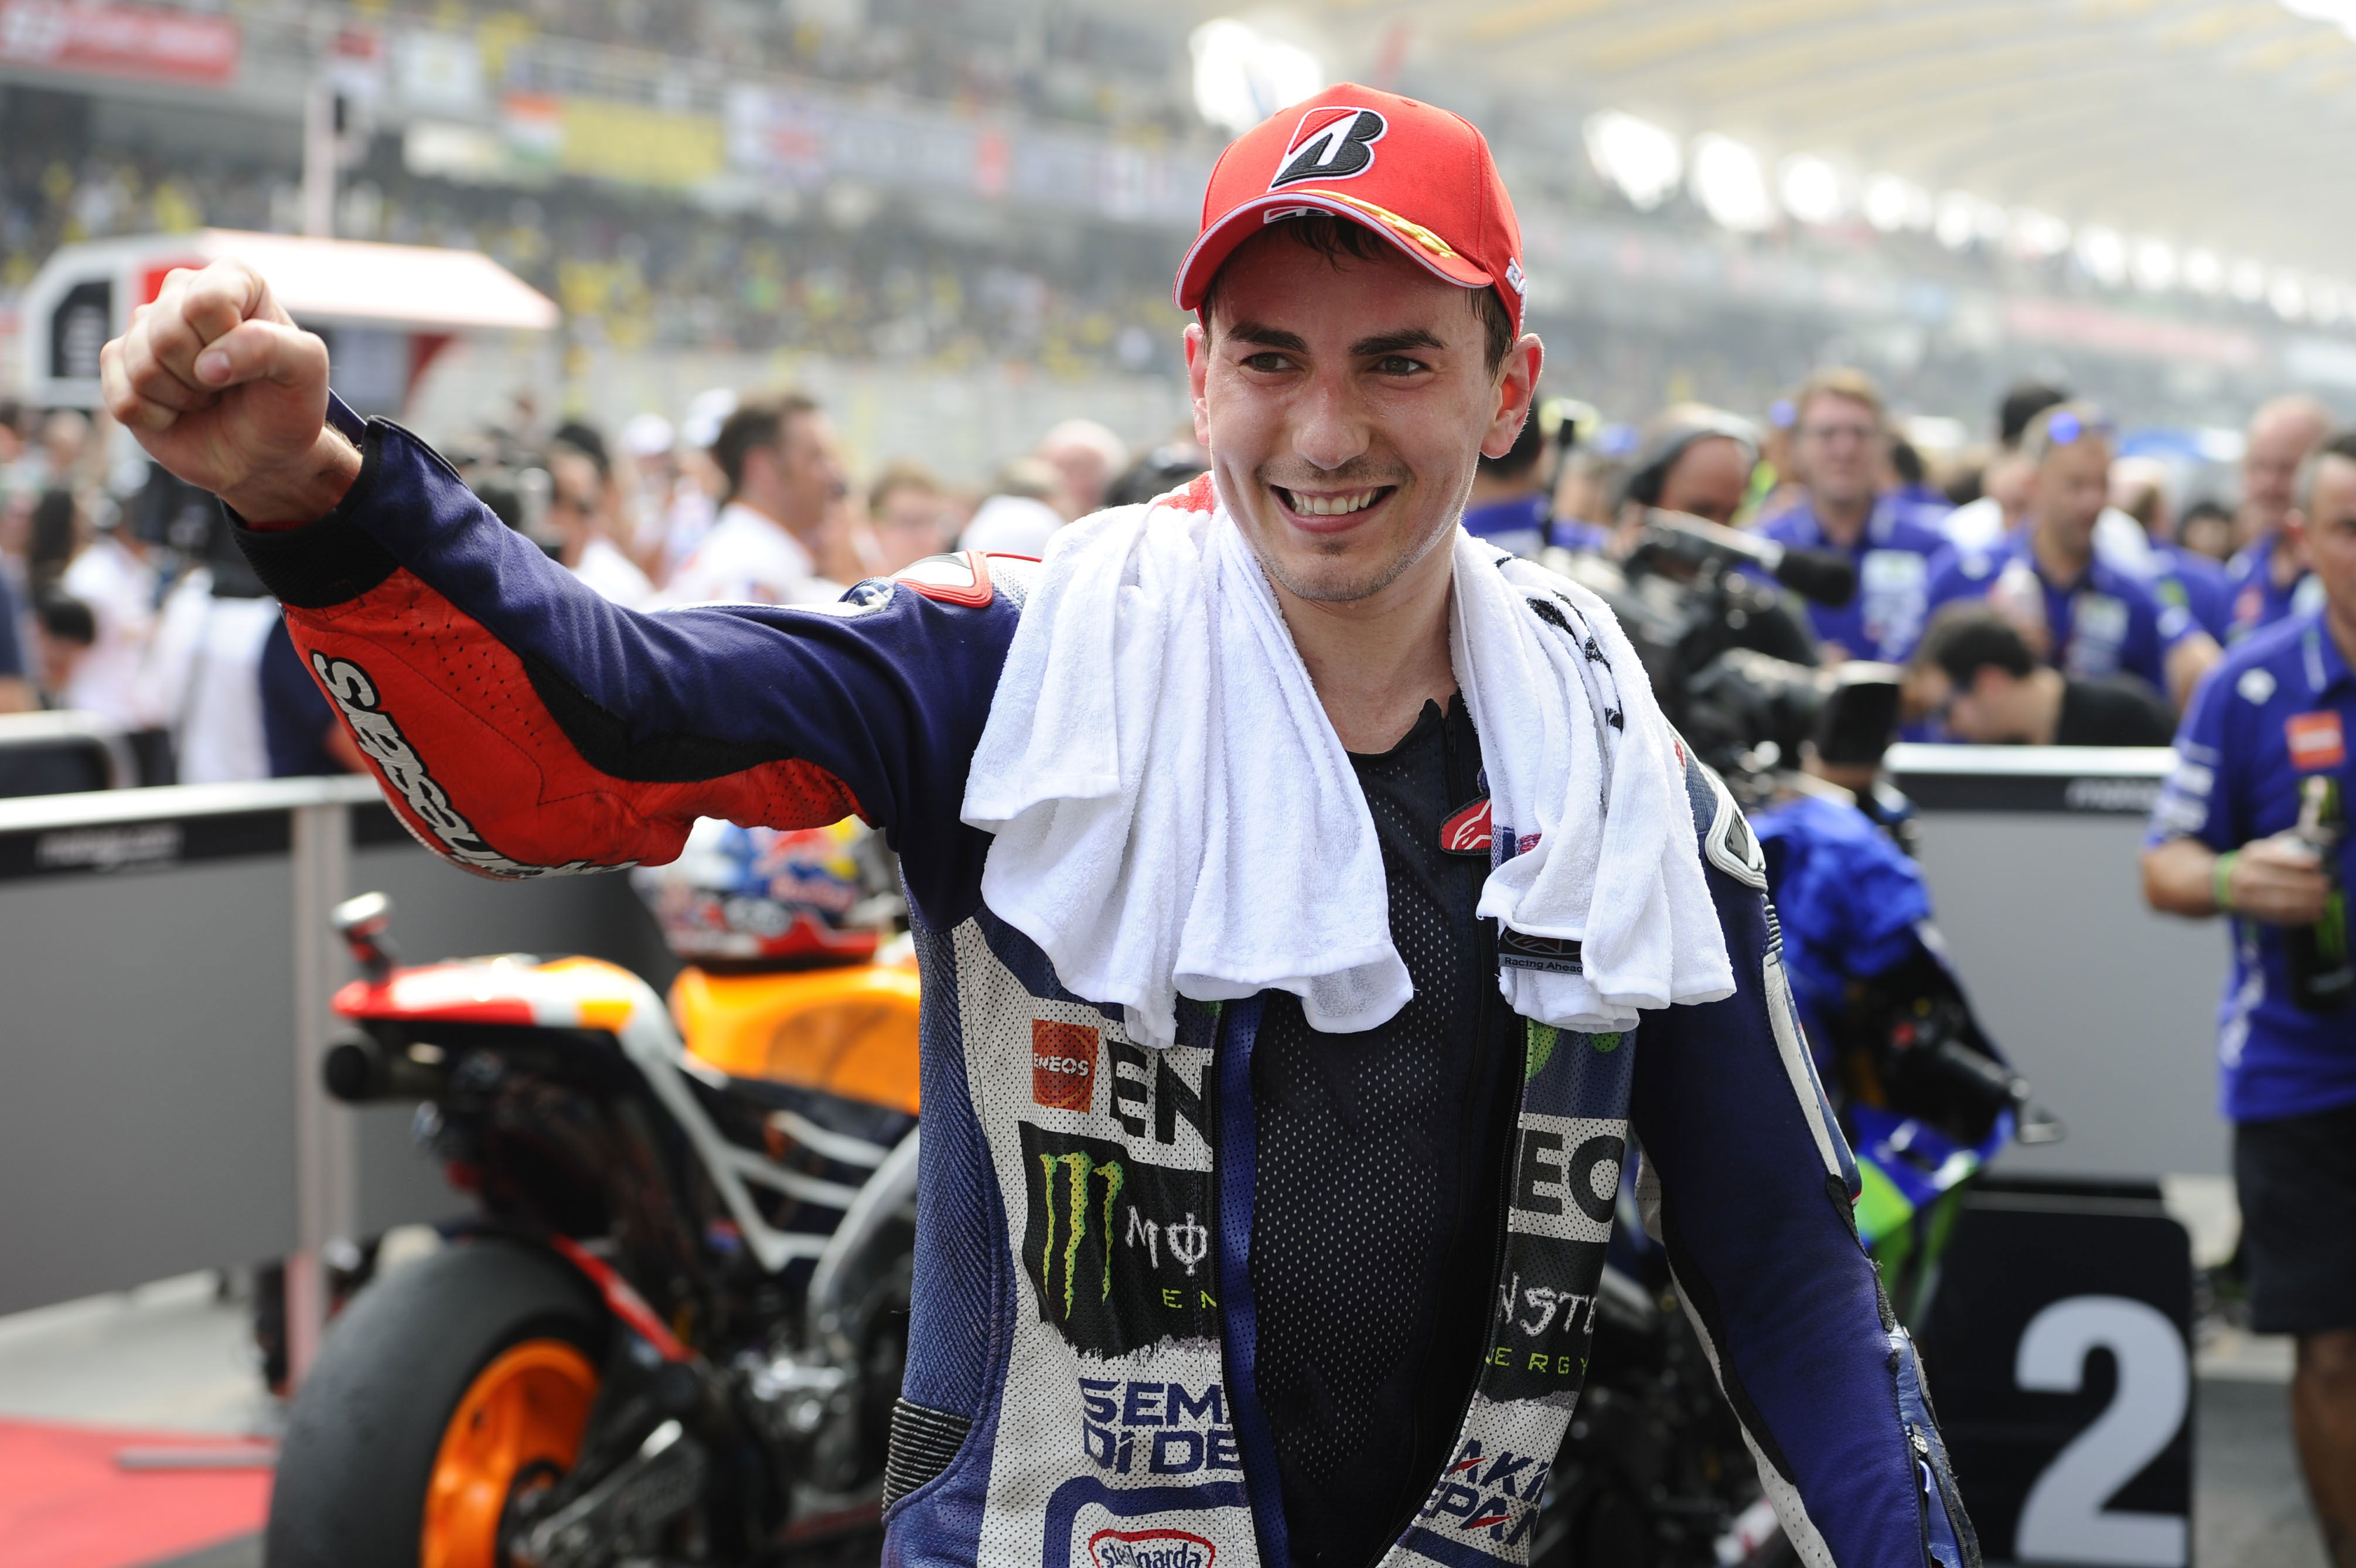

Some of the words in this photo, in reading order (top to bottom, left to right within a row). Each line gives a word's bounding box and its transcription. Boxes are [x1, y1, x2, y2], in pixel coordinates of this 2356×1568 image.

[1504, 956, 1543, 970] Racing
[1034, 1052, 1089, 1076] ENEOS
[2014, 1294, 2190, 1567] 2
